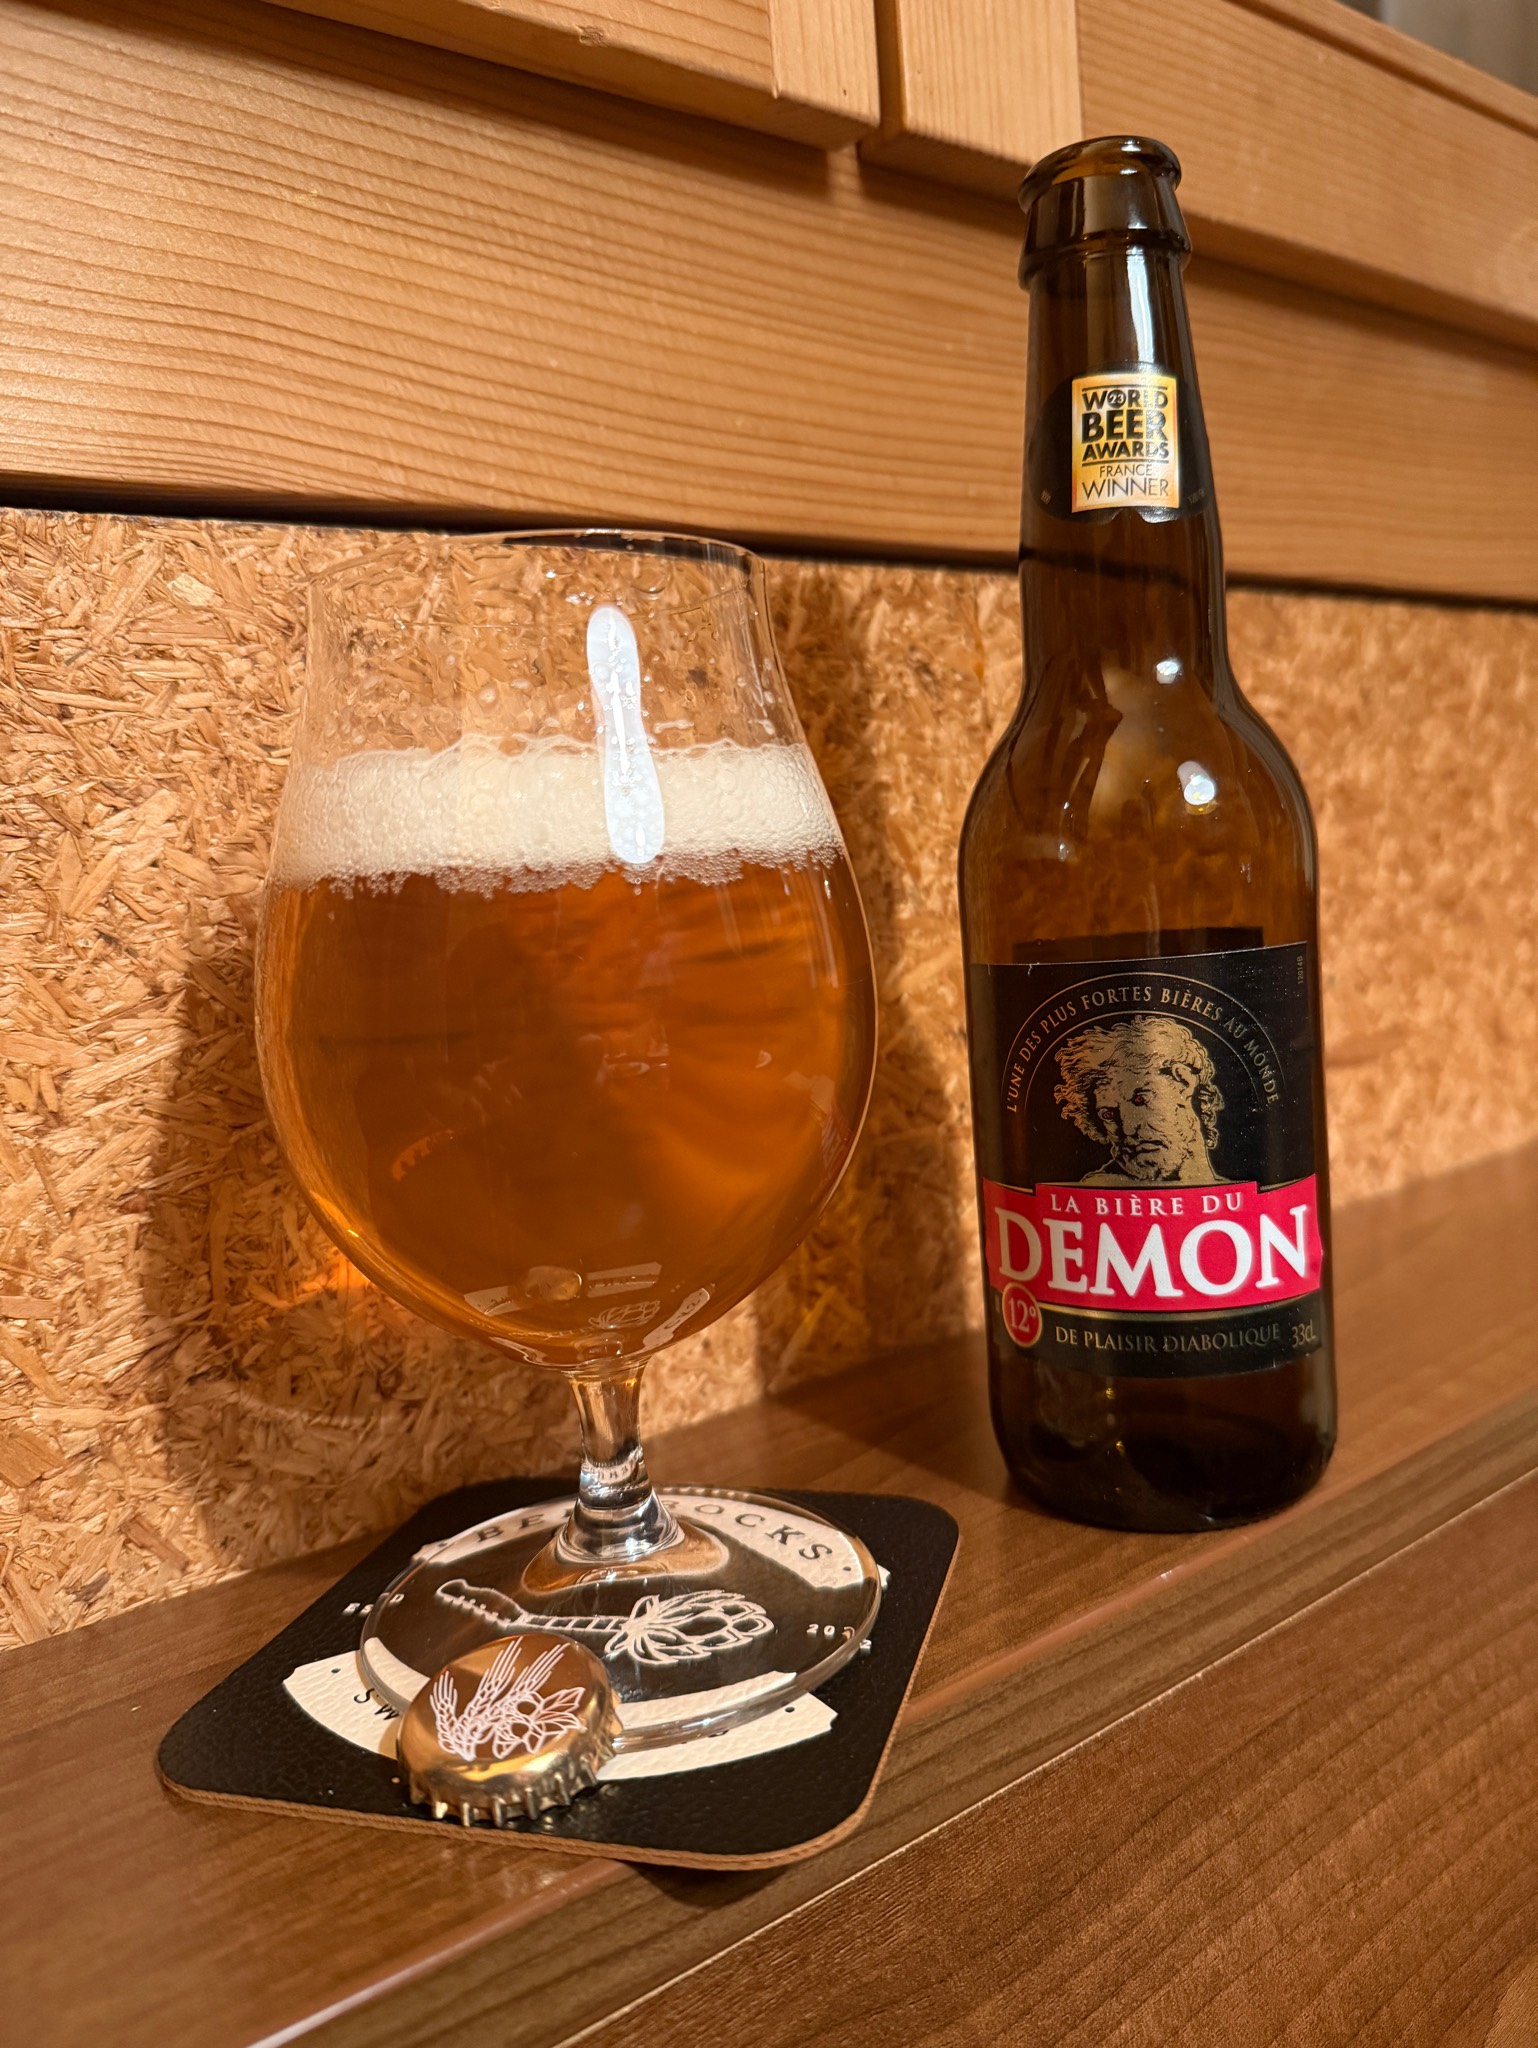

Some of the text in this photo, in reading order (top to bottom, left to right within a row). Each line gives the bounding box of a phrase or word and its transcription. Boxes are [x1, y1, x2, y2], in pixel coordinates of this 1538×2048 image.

[1082, 409, 1168, 443] BEER
[1082, 441, 1169, 461] AWARDS
[1100, 464, 1152, 477] FRANCE
[1082, 478, 1169, 499] WINNER
[1007, 986, 1279, 1112] L'UNE DES PLUS FORTES BIÈRES AU MONDE
[1050, 1192, 1242, 1216] LA BIÈRE DU
[995, 1204, 1307, 1297] DEMON
[1056, 1323, 1280, 1353] DE PLAISIR DIABOLIQUE
